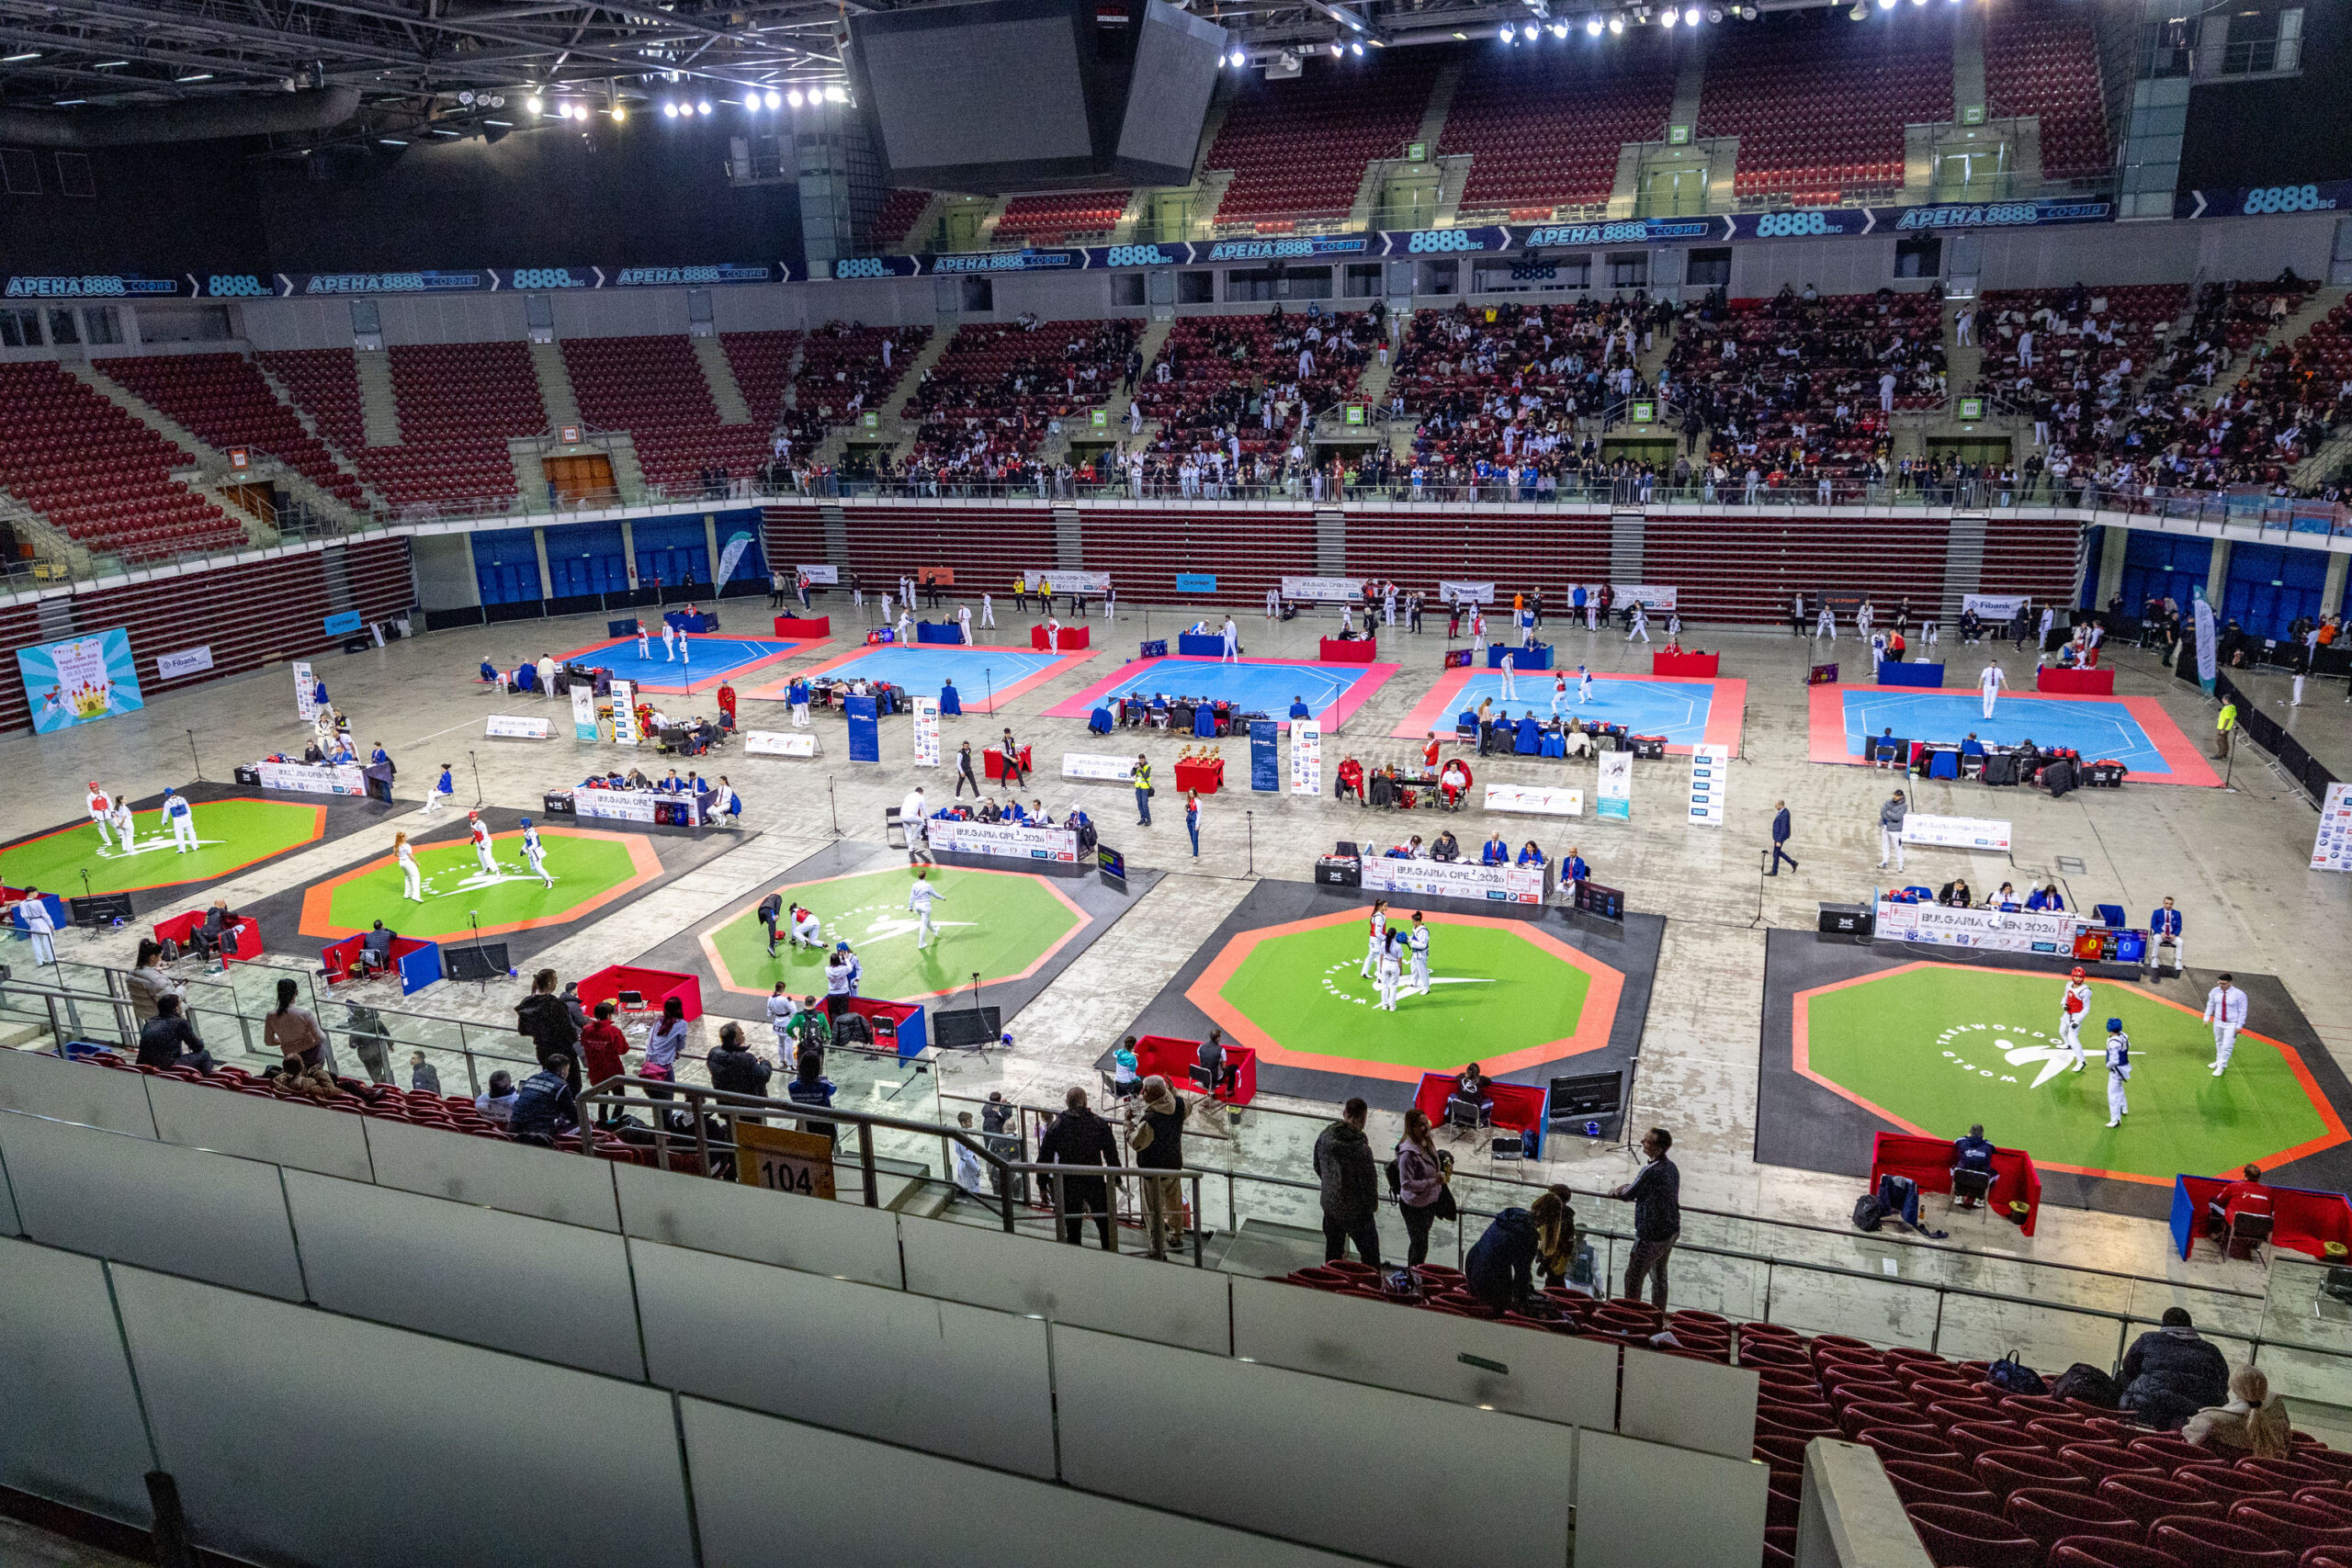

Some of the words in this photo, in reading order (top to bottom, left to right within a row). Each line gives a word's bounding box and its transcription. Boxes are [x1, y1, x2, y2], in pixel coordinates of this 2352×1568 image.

[1655, 225, 1702, 235] СОФИЯ
[1320, 241, 1361, 251] СОФИЯ
[1030, 256, 1066, 265] СОФИЯ
[1980, 602, 2010, 610] Fibank
[172, 656, 198, 667] Fibank
[956, 828, 998, 839] BULGARIA
[1023, 834, 1045, 843] 2026
[1396, 865, 1447, 879] BULGARIA
[1479, 873, 1505, 883] 2026
[1921, 912, 1984, 928] BULGARIA
[2024, 921, 2055, 933] 2026
[1918, 934, 1939, 942] Daedo
[2088, 939, 2097, 950] 0
[2123, 942, 2132, 952] 0
[773, 1024, 787, 1033] CZE
[763, 1161, 813, 1195] 104
